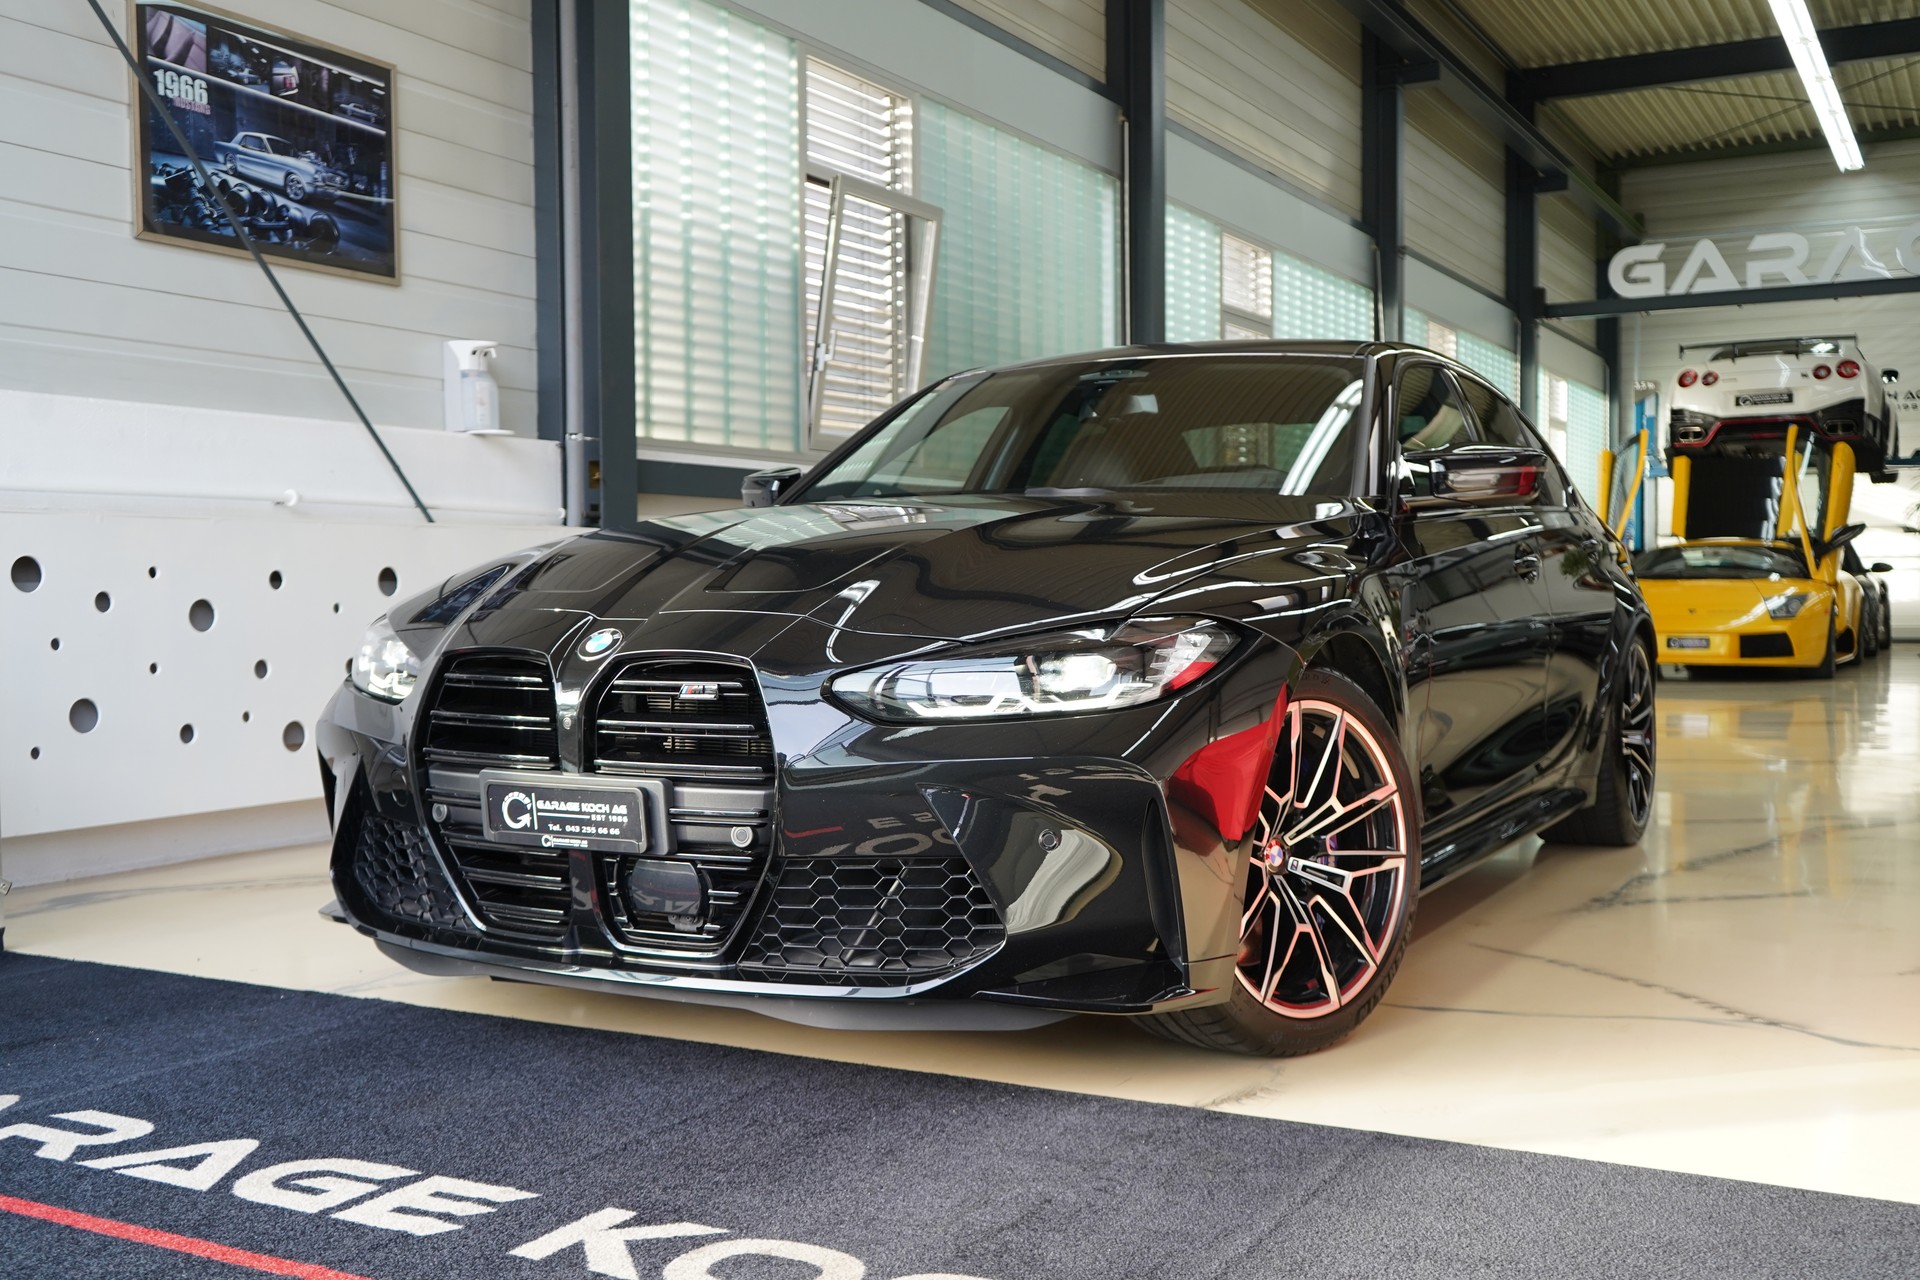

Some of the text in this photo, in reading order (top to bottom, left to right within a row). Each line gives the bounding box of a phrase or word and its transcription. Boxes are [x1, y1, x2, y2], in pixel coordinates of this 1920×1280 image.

[153, 69, 209, 105] 1966
[172, 96, 211, 115] MUSTANG
[536, 800, 628, 815] GARAGE KOCH AG
[591, 814, 606, 822] EST
[548, 823, 620, 836] Tel. 043 255 66 66
[0, 1094, 1011, 1280] RAGE KO
